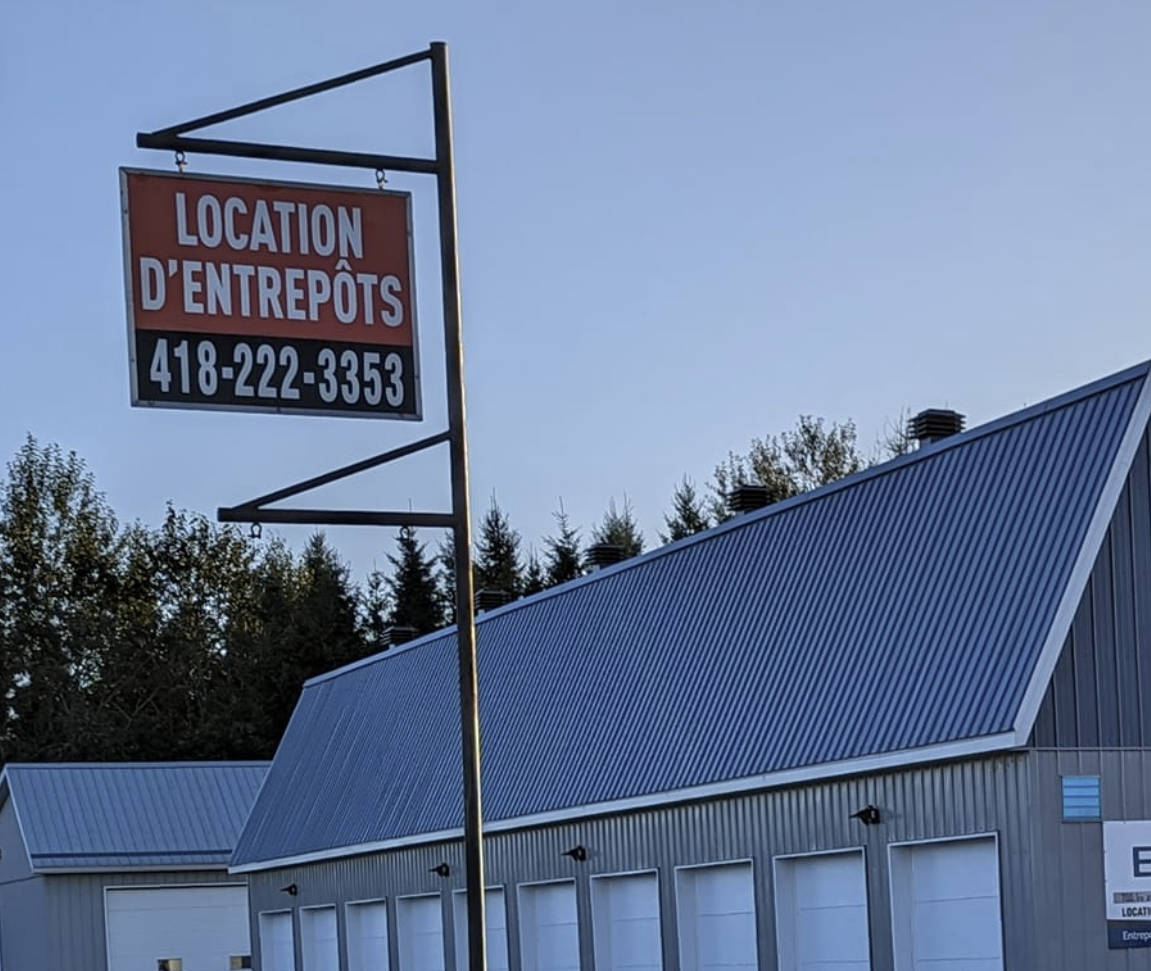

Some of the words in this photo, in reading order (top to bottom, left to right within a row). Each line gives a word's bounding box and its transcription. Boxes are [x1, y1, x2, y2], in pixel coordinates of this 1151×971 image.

[175, 192, 363, 259] LOCATION
[139, 256, 404, 327] D'ENTREPÔTS
[150, 338, 404, 407] 418-222-3353
